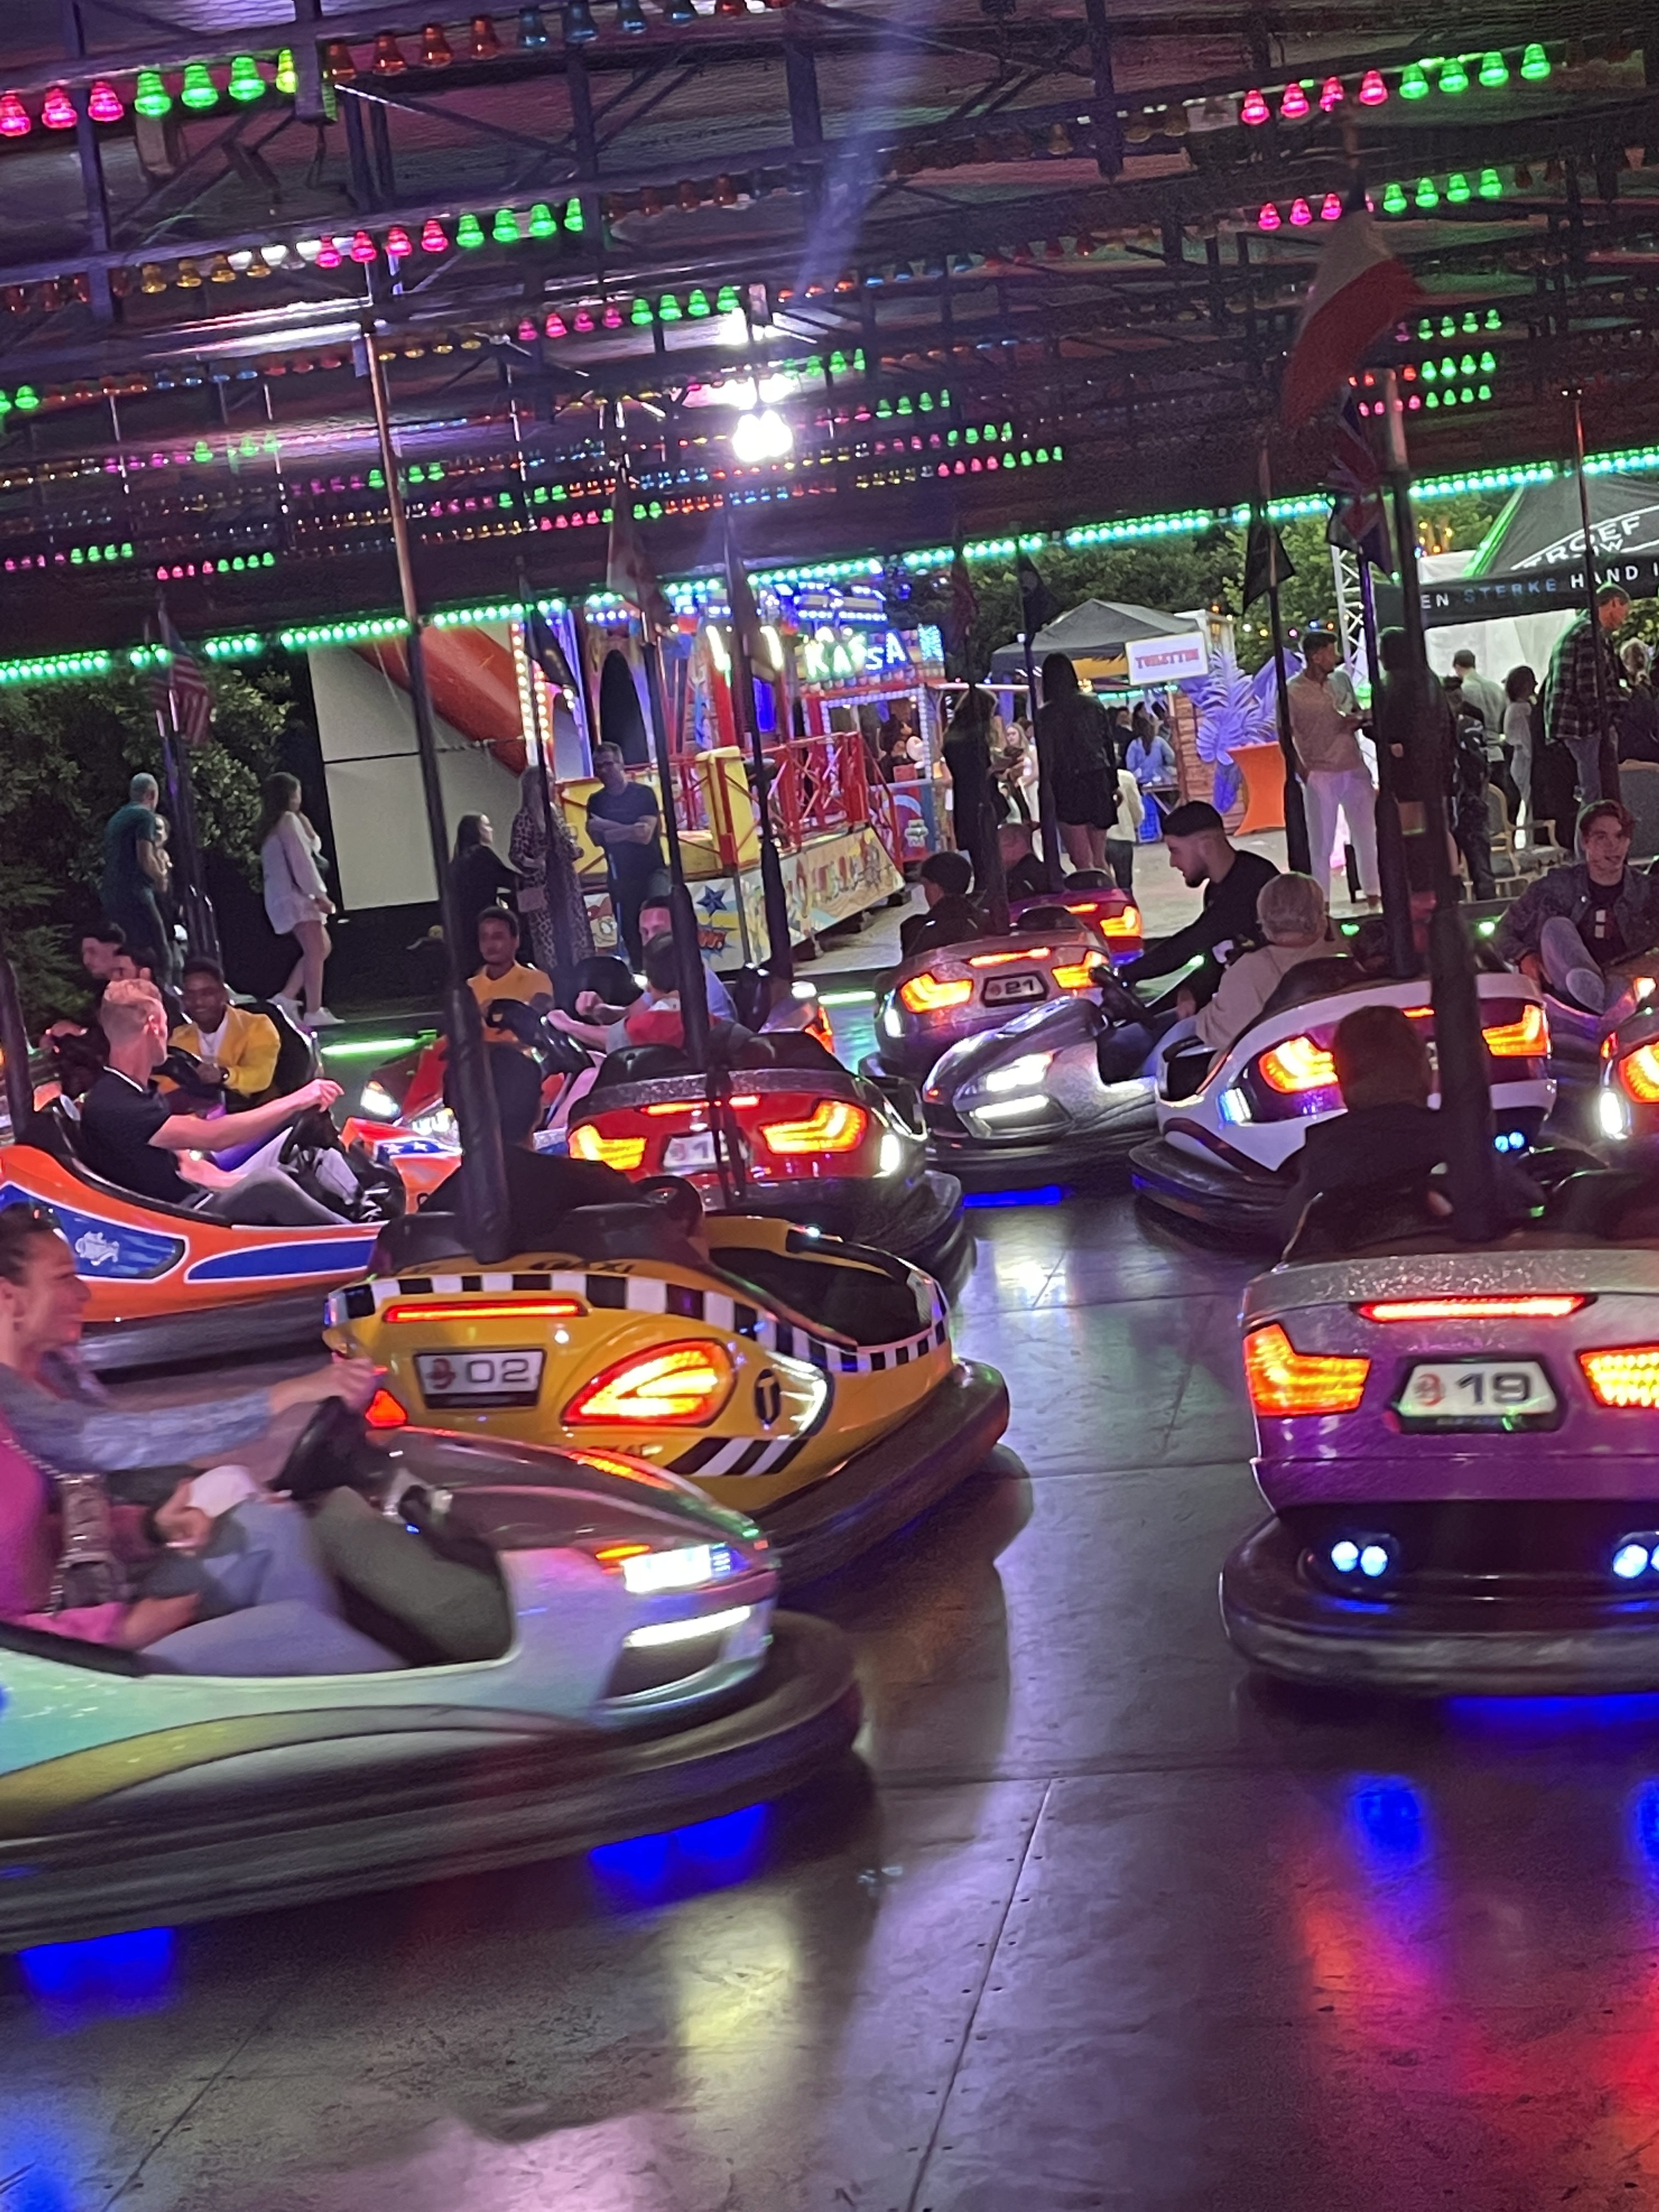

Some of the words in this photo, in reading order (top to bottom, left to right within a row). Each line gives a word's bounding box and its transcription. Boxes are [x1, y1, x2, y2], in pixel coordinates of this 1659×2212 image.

[1464, 578, 1557, 603] STERKE
[804, 632, 906, 679] KASSA
[1005, 979, 1034, 995] 21
[466, 1358, 529, 1384] 02
[1456, 1372, 1531, 1405] 19
